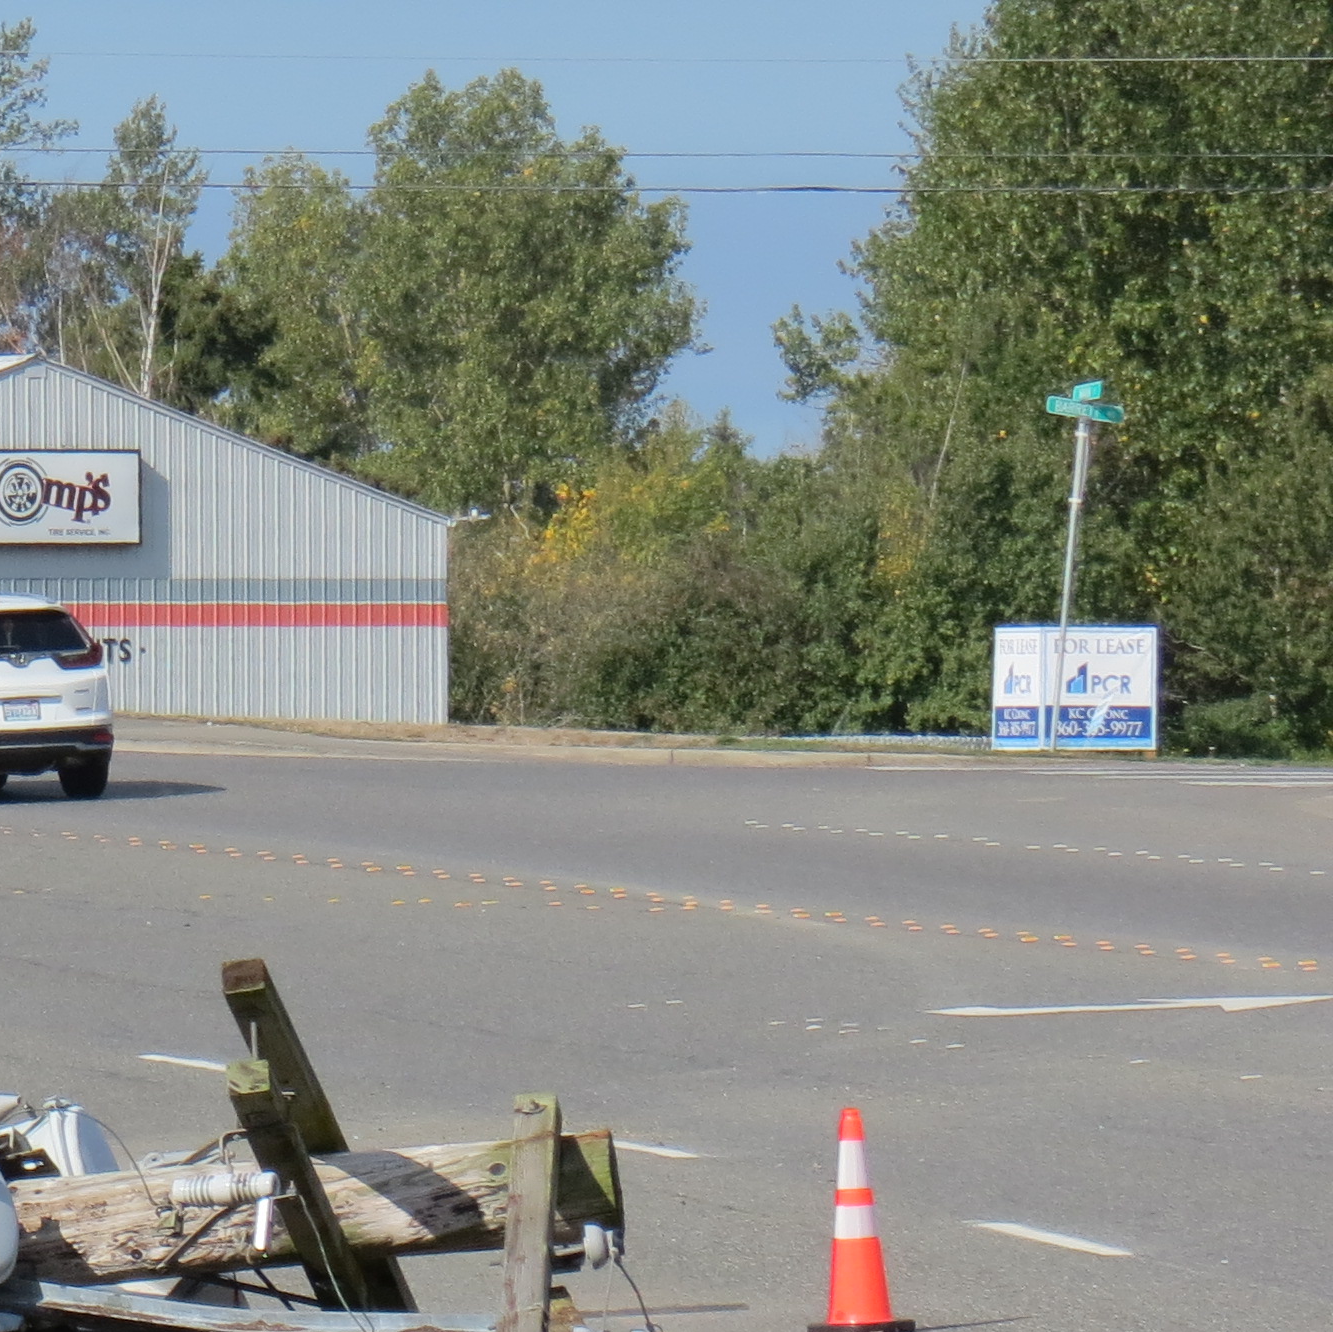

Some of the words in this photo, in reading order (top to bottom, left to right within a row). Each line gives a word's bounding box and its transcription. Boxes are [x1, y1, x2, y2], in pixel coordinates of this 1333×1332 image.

[1000, 639, 1014, 655] FOR
[1017, 639, 1038, 655] LEASE
[1053, 638, 1090, 655] FOR
[1096, 638, 1145, 655] LEASE
[1091, 675, 1131, 694] PCR
[1068, 708, 1085, 719] KC
